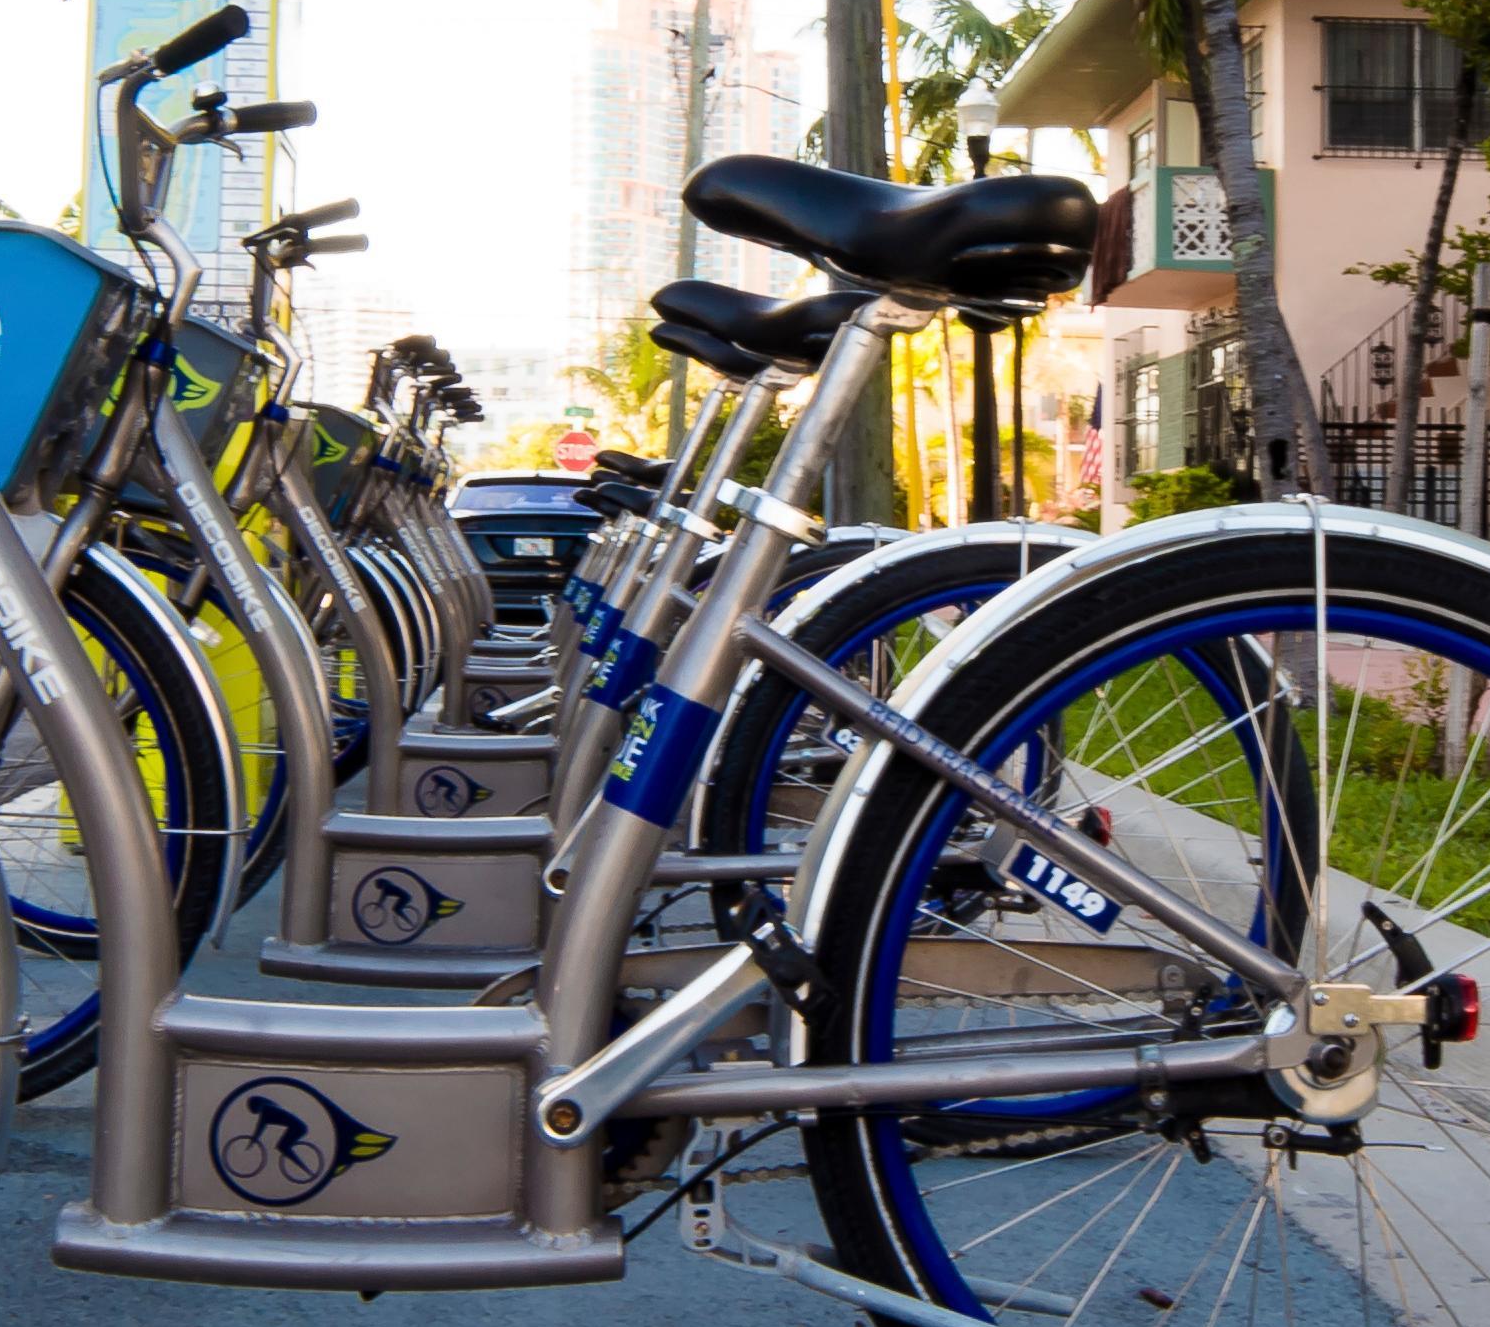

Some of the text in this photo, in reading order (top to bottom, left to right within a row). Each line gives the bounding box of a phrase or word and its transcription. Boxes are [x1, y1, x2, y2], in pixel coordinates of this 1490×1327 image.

[557, 443, 598, 461] STOP
[176, 481, 274, 632] DECOBIKE
[1025, 853, 1108, 918] 1149
